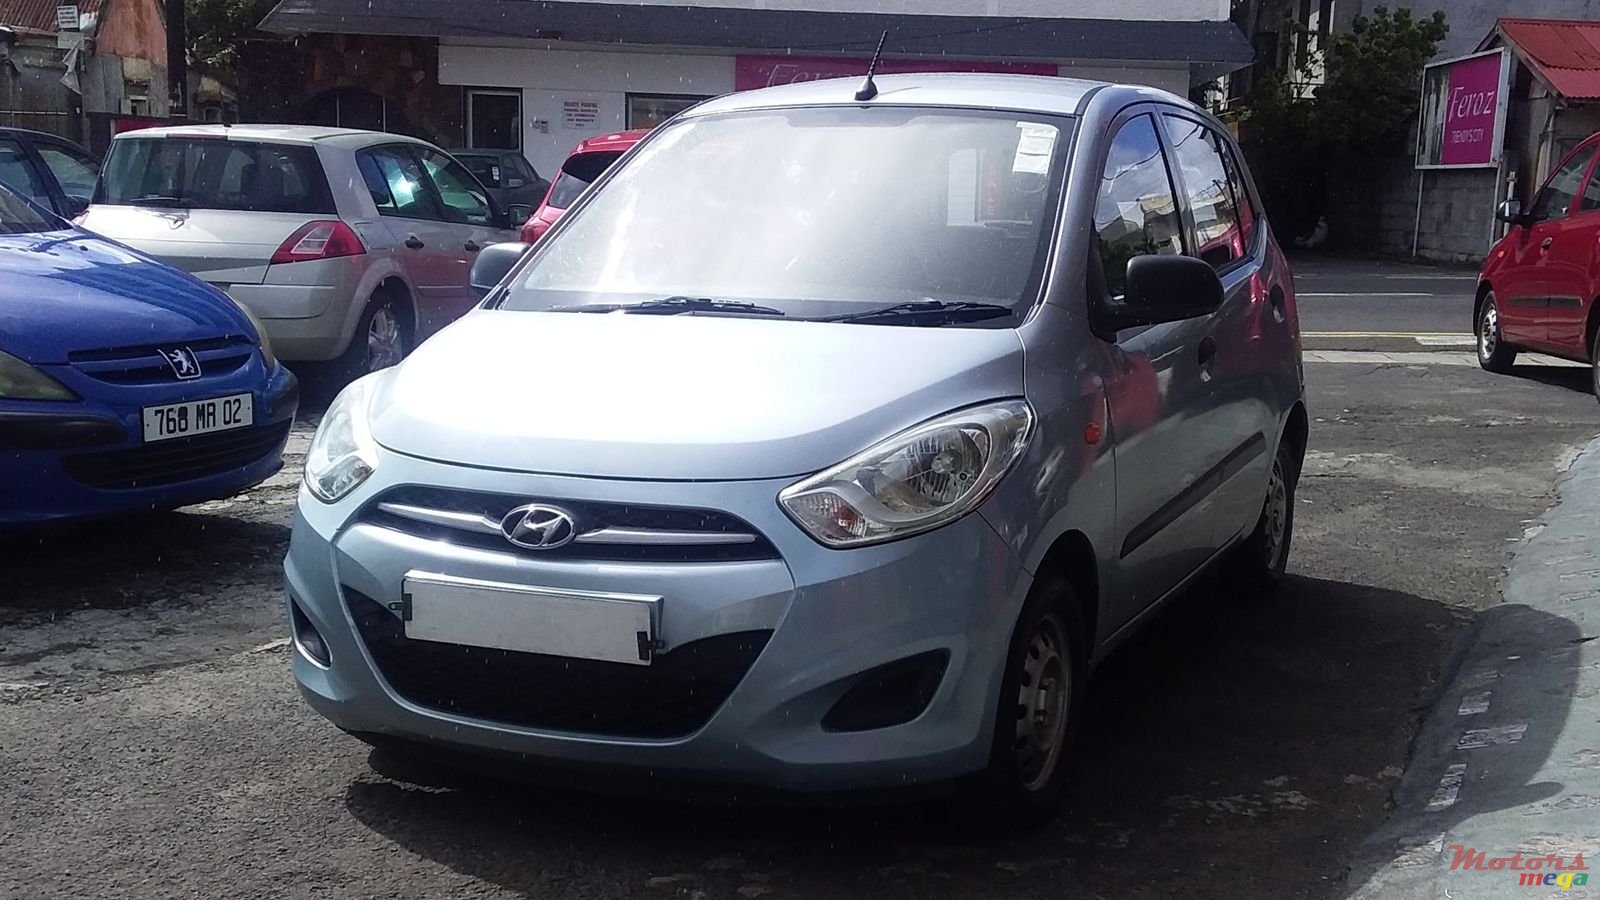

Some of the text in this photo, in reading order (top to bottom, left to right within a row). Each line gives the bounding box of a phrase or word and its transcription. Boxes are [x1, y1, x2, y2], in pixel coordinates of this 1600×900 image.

[1448, 86, 1495, 122] Feroz
[154, 406, 188, 436] 768
[223, 398, 242, 425] 02
